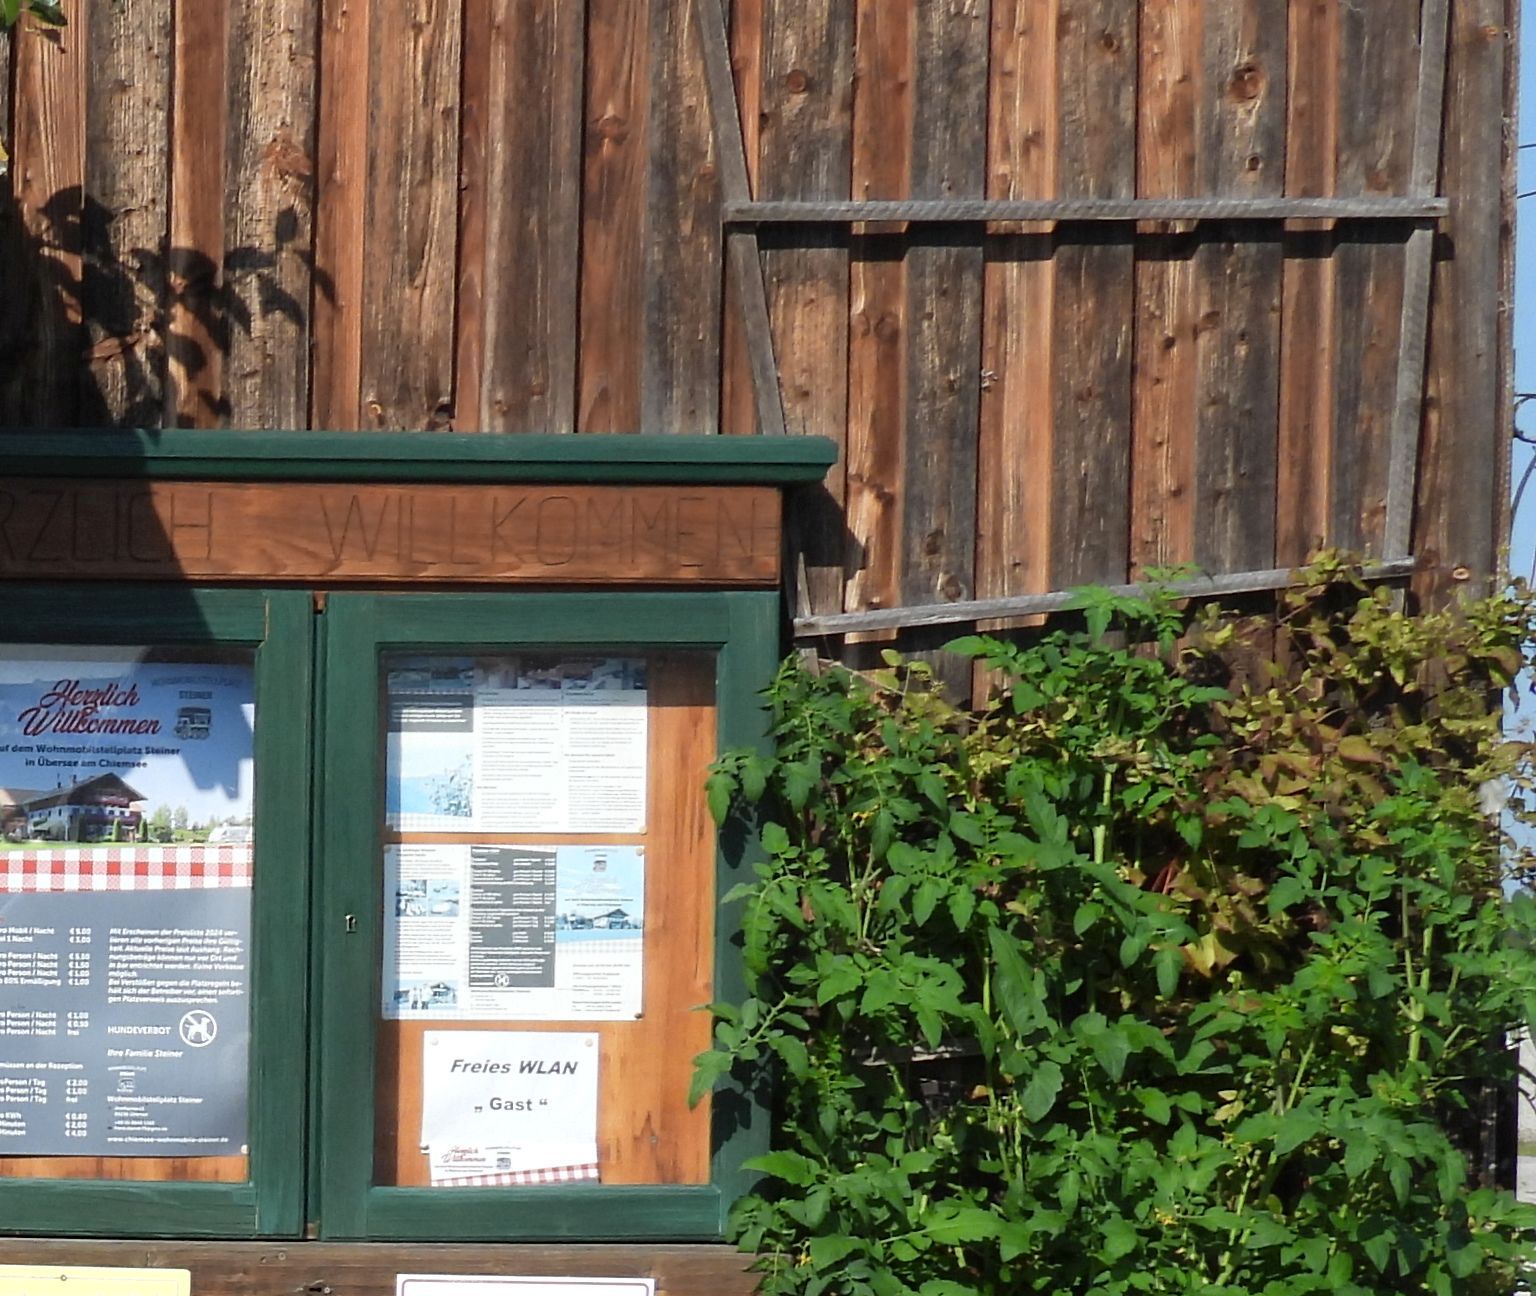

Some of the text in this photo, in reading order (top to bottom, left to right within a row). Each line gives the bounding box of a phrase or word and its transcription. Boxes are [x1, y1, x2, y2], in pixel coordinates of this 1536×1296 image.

[320, 494, 756, 567] WILLKOMMEN
[39, 678, 141, 709] Herzlich
[18, 705, 162, 737] Willkommen
[11, 744, 34, 753] dem
[144, 746, 181, 755] Steiner
[24, 758, 36, 767] in
[80, 760, 97, 768] am
[98, 759, 148, 768] Chiemsee
[107, 1026, 172, 1035] HUNDEVERBOT
[124, 1049, 154, 1057] Familie
[154, 1050, 184, 1058] Steiner
[450, 1059, 579, 1076] Freies WLAN
[489, 1097, 533, 1112] Gast
